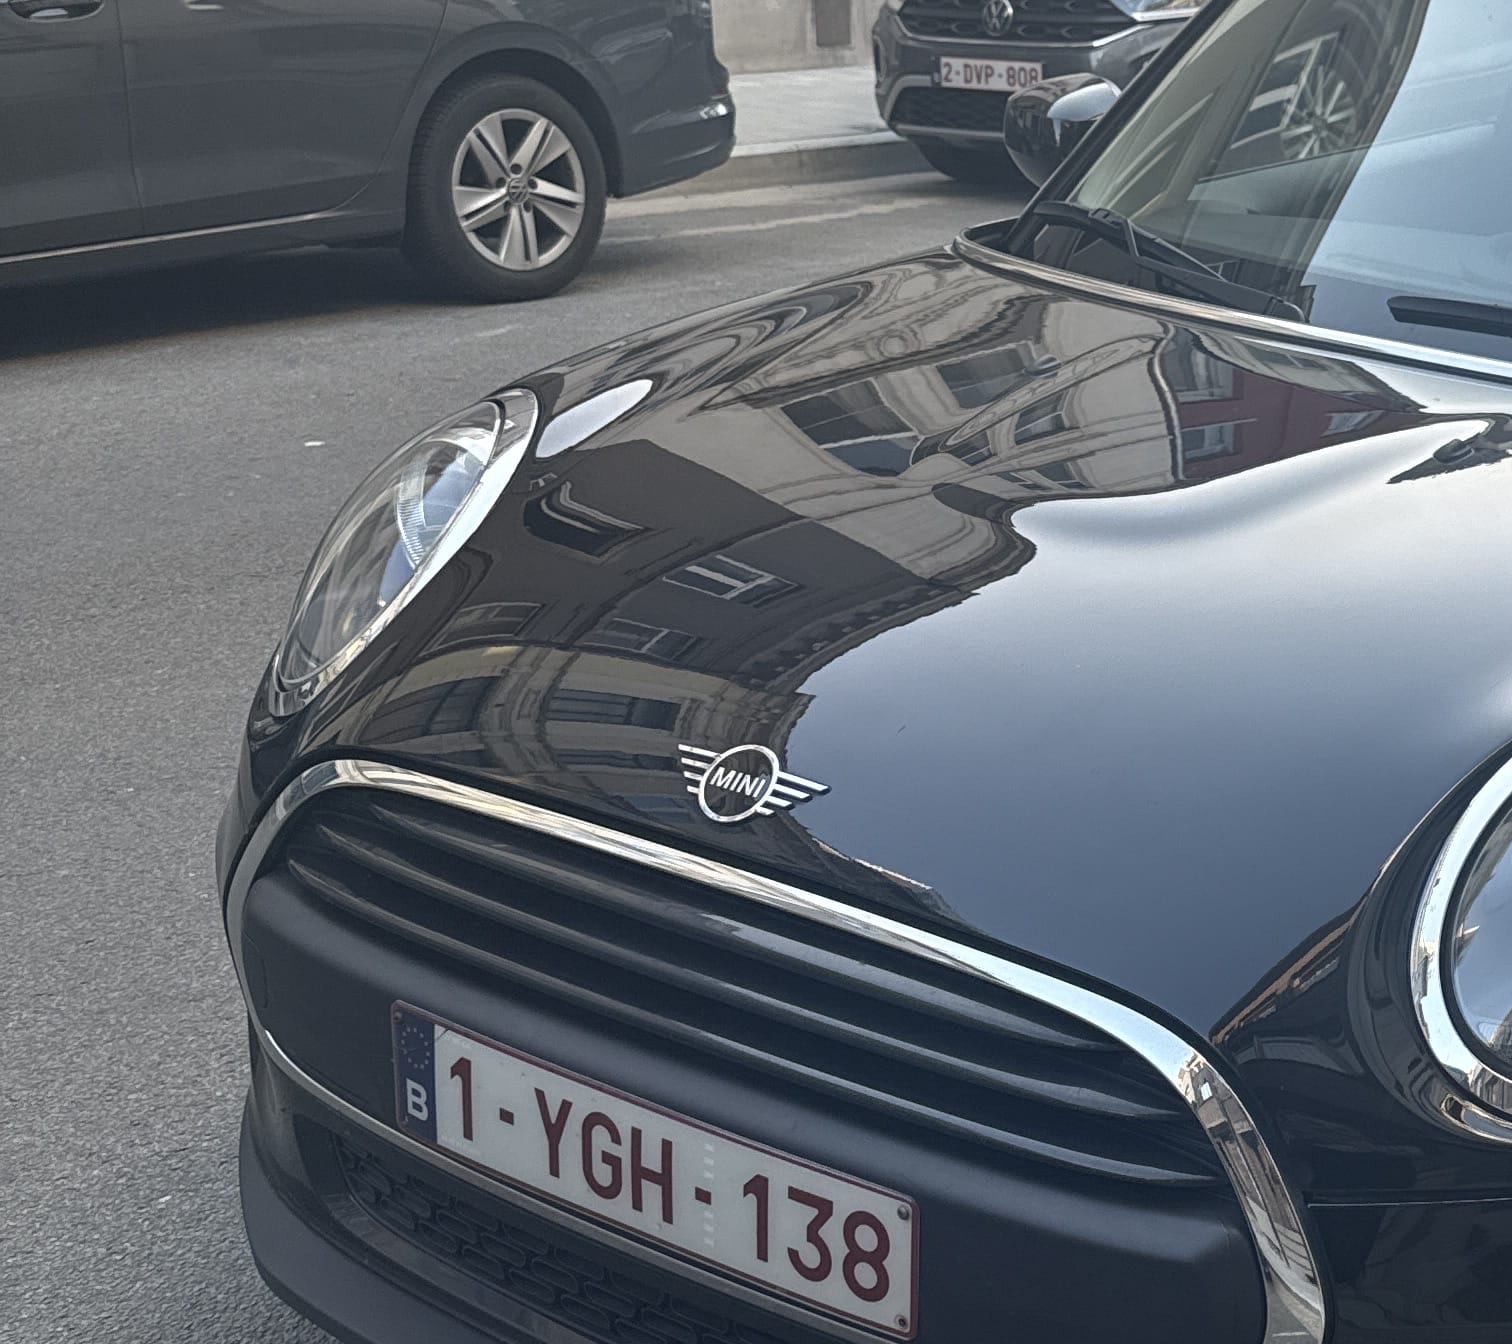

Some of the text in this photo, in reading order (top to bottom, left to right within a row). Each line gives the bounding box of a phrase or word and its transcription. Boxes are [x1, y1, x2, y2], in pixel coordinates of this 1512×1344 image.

[709, 766, 766, 798] MINI
[405, 1079, 429, 1121] B
[450, 1056, 891, 1303] 1-YGH-138
